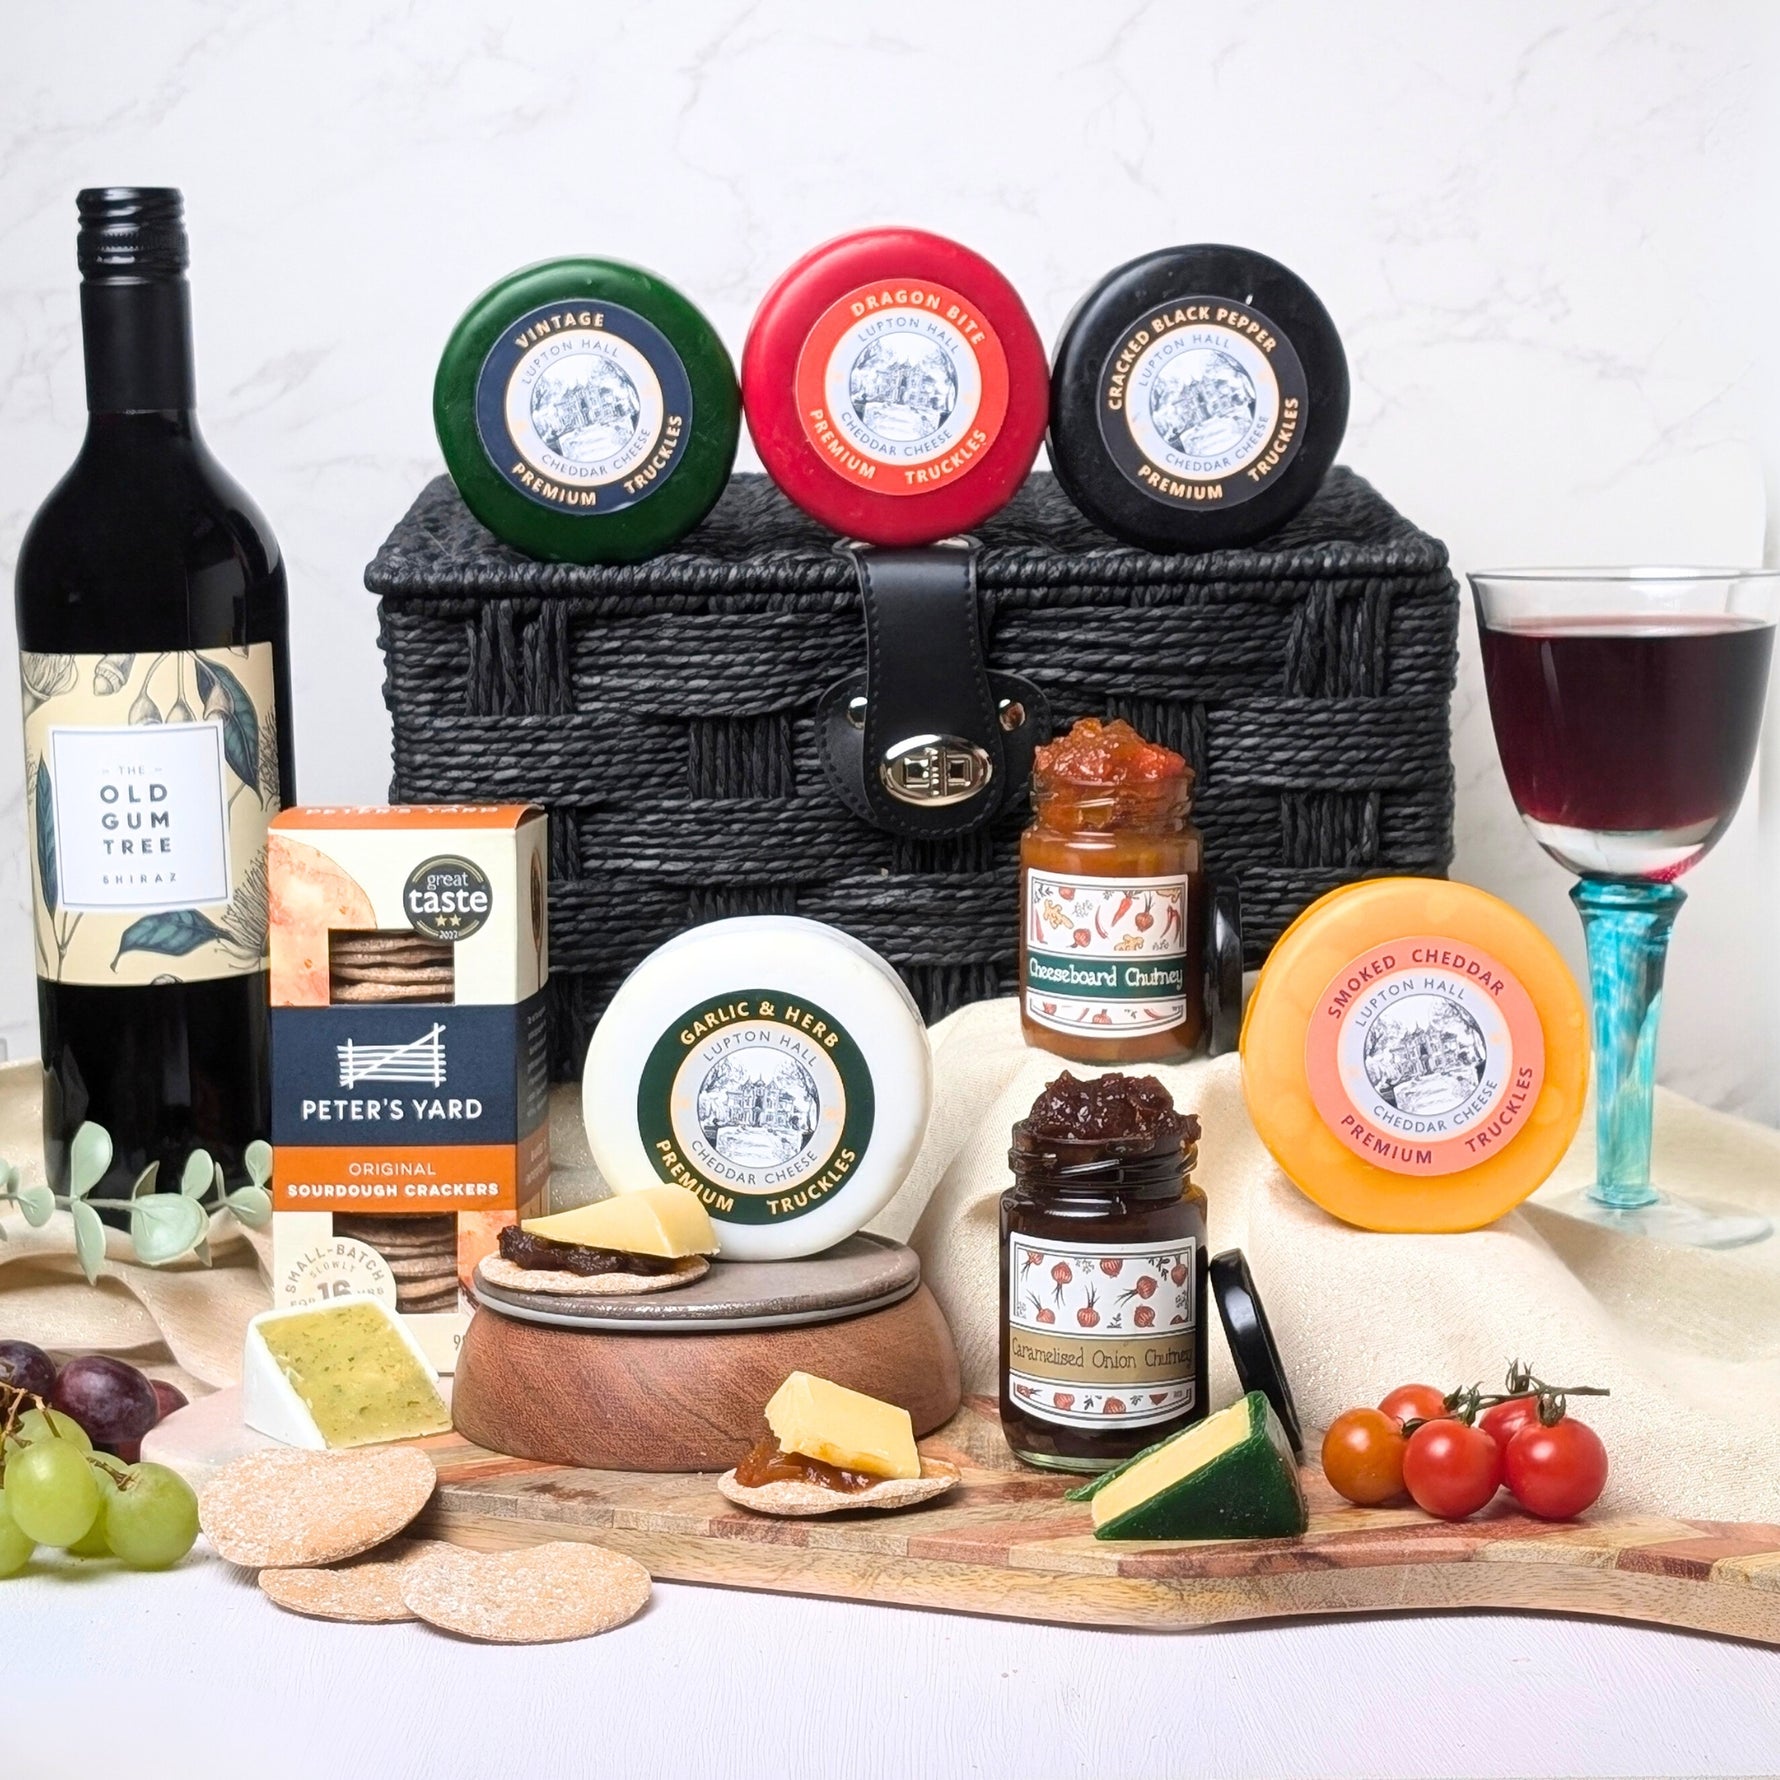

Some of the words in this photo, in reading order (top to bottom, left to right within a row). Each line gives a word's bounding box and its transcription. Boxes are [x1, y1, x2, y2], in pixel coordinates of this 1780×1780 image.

[515, 312, 604, 350] VINTAGE
[850, 290, 941, 318] DRAGON
[947, 304, 986, 344] BITE
[857, 317, 920, 343] LUPTON
[927, 324, 960, 355] HALL
[522, 340, 572, 385] LUPTON
[582, 338, 619, 358] HALL
[1108, 330, 1150, 411] CRACKED
[1152, 306, 1210, 333] BLACK
[1216, 307, 1278, 354] PEPPER
[1139, 338, 1184, 387] LUPTON
[1193, 334, 1230, 349] HALL
[541, 454, 608, 478] CHEDDAR
[613, 428, 651, 470] CHEESE
[810, 408, 876, 480] PREMIUM
[905, 429, 988, 485] TRUCKLES
[840, 411, 898, 456] CHEDDAR
[904, 428, 953, 457] CHEESE
[1137, 464, 1224, 500] PREMIUM
[1248, 397, 1299, 482] TRUCKLES
[1165, 452, 1232, 472] CHEDDAR
[1235, 415, 1270, 460] CHEESE
[512, 462, 597, 506] PREMIUM
[623, 414, 683, 495] TRUCKLES
[100, 784, 168, 804] OLD
[118, 766, 146, 776] THE
[101, 811, 170, 830] GUM
[103, 838, 172, 855] TREE
[102, 872, 176, 884] SHIRAZ
[409, 889, 488, 913] taste
[426, 872, 469, 890] great
[1029, 958, 1118, 988] Cheeseboard
[1125, 967, 1182, 990] Chutney
[1328, 954, 1396, 1019] SMOKED
[1412, 948, 1506, 996] CHEDDAR
[680, 1001, 750, 1046] GARLIC
[759, 1001, 776, 1017] &
[784, 1005, 839, 1048] HERB
[1355, 978, 1414, 1028] LUPTON
[1424, 978, 1466, 1000] HALL
[703, 1030, 771, 1062] LUPTON
[780, 1033, 818, 1068] HALL
[302, 1098, 404, 1120] PETER'S
[413, 1098, 482, 1120] YARD
[1340, 1114, 1432, 1164] PREMIUM
[1465, 1066, 1534, 1153] TRUCKLES
[1373, 1104, 1448, 1133] CHEDDAR
[1454, 1078, 1498, 1126] CHEESE
[349, 1162, 436, 1176] ORIGINAL
[656, 1138, 734, 1213] PREMIUM
[766, 1148, 856, 1216] TRUCKLES
[691, 1140, 757, 1185] CHEDDAR
[764, 1150, 819, 1185] CHEESE
[288, 1184, 398, 1198] SOURDOUGH
[404, 1183, 498, 1196] CRACKERS
[286, 1244, 385, 1294] SMALL-BATCH
[1012, 1338, 1084, 1368] Caramelised
[1092, 1350, 1136, 1368] Onion
[1144, 1348, 1192, 1370] Chutney
